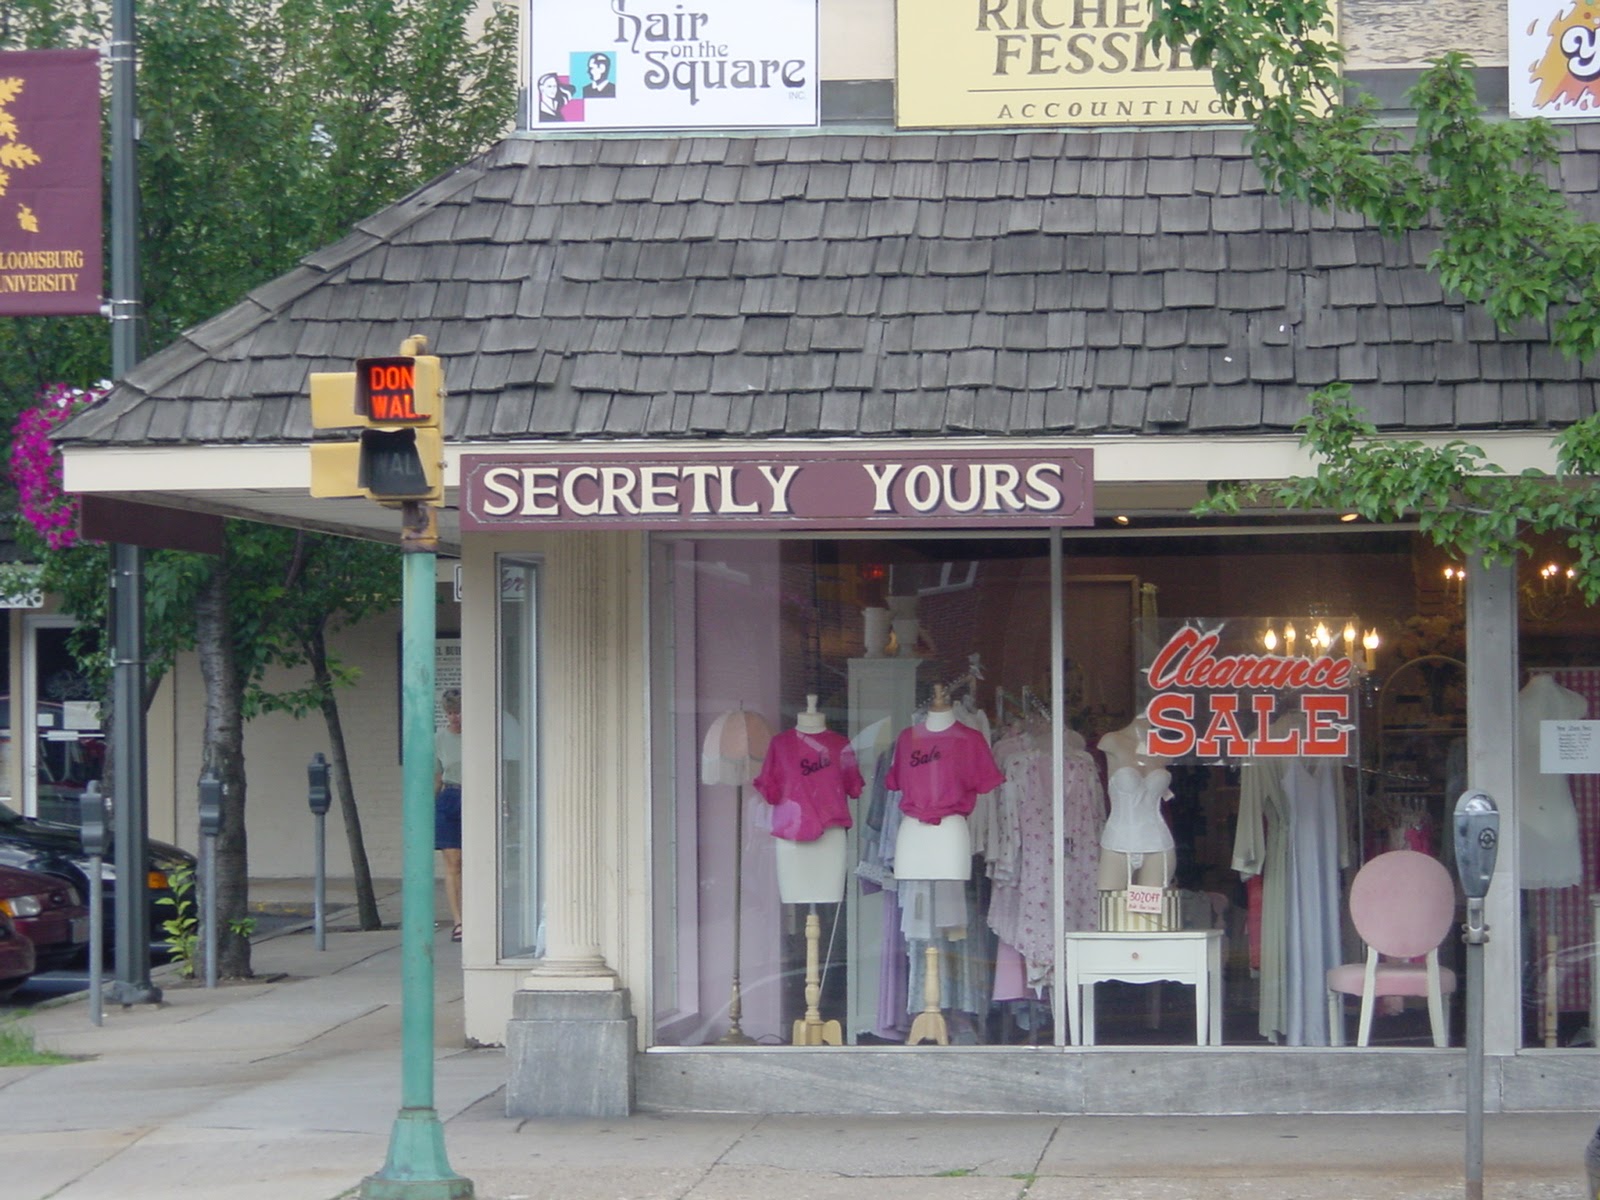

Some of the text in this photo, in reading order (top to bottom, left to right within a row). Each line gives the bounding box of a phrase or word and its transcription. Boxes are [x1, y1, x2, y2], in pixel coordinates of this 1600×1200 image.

[975, 0, 1160, 31] RICHE
[670, 40, 728, 58] on the
[992, 32, 1216, 76] FESSLE
[644, 50, 806, 106] Square
[997, 99, 1223, 119] ACCOUNTING
[0, 250, 84, 270] LOOMSBURG
[370, 366, 416, 391] DON
[371, 394, 417, 419] WAL
[483, 462, 1063, 516] SECRETLY YOURS
[1147, 626, 1352, 690] Clearance
[1147, 692, 1349, 757] SALE
[800, 756, 831, 776] Sale
[907, 745, 941, 767] Sale
